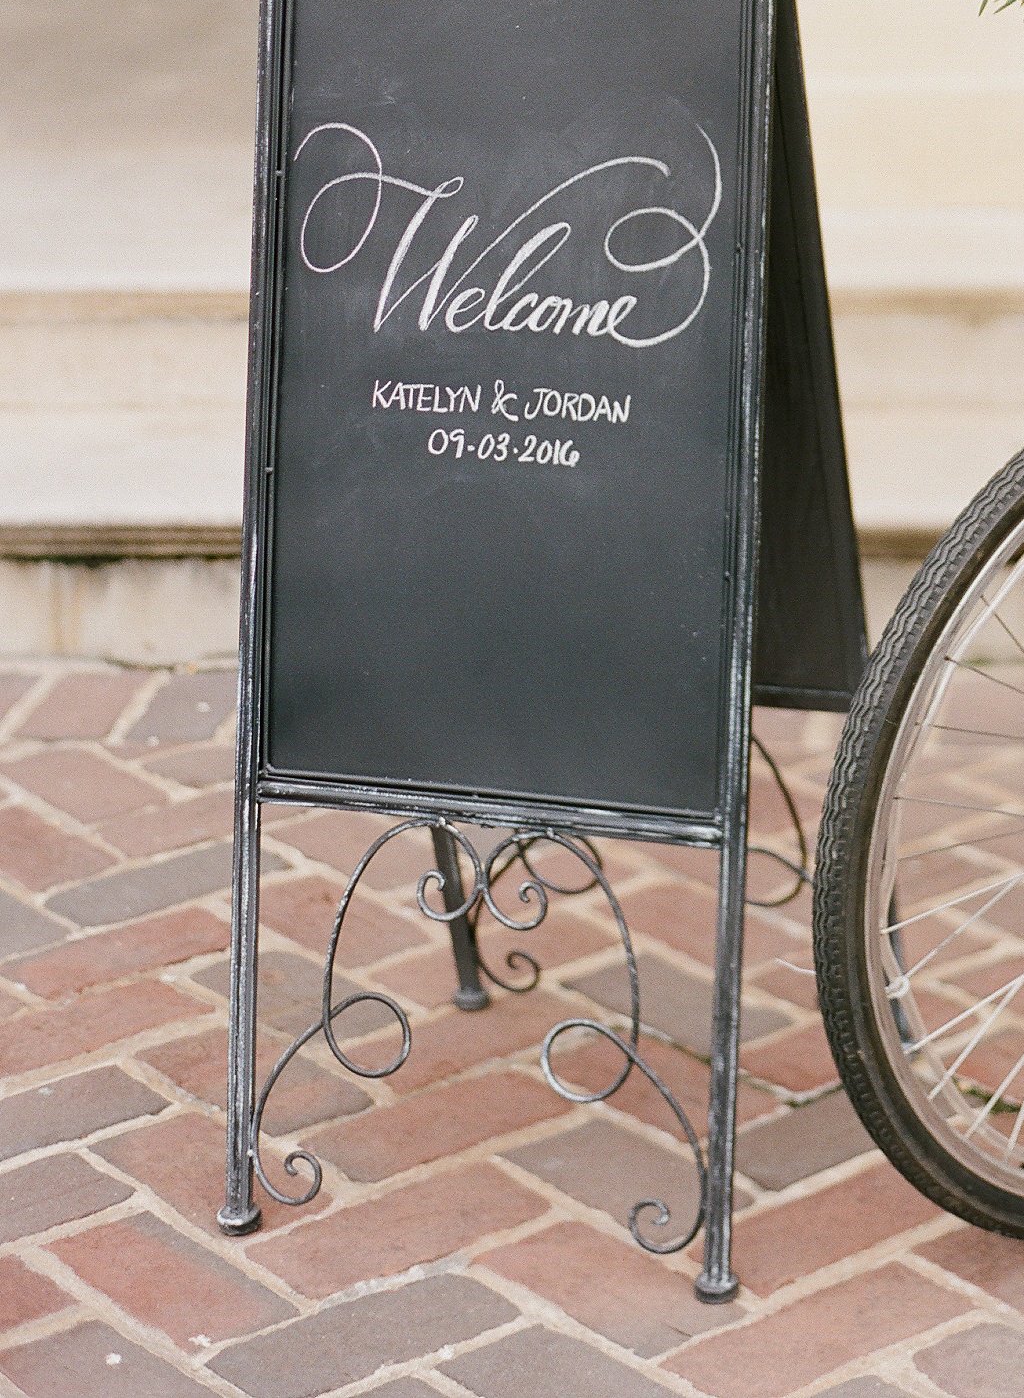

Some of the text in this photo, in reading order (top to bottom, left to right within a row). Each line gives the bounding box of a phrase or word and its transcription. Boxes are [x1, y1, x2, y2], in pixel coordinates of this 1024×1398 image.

[293, 122, 722, 348] Welcome
[372, 379, 631, 424] KATELYN & JORDAN
